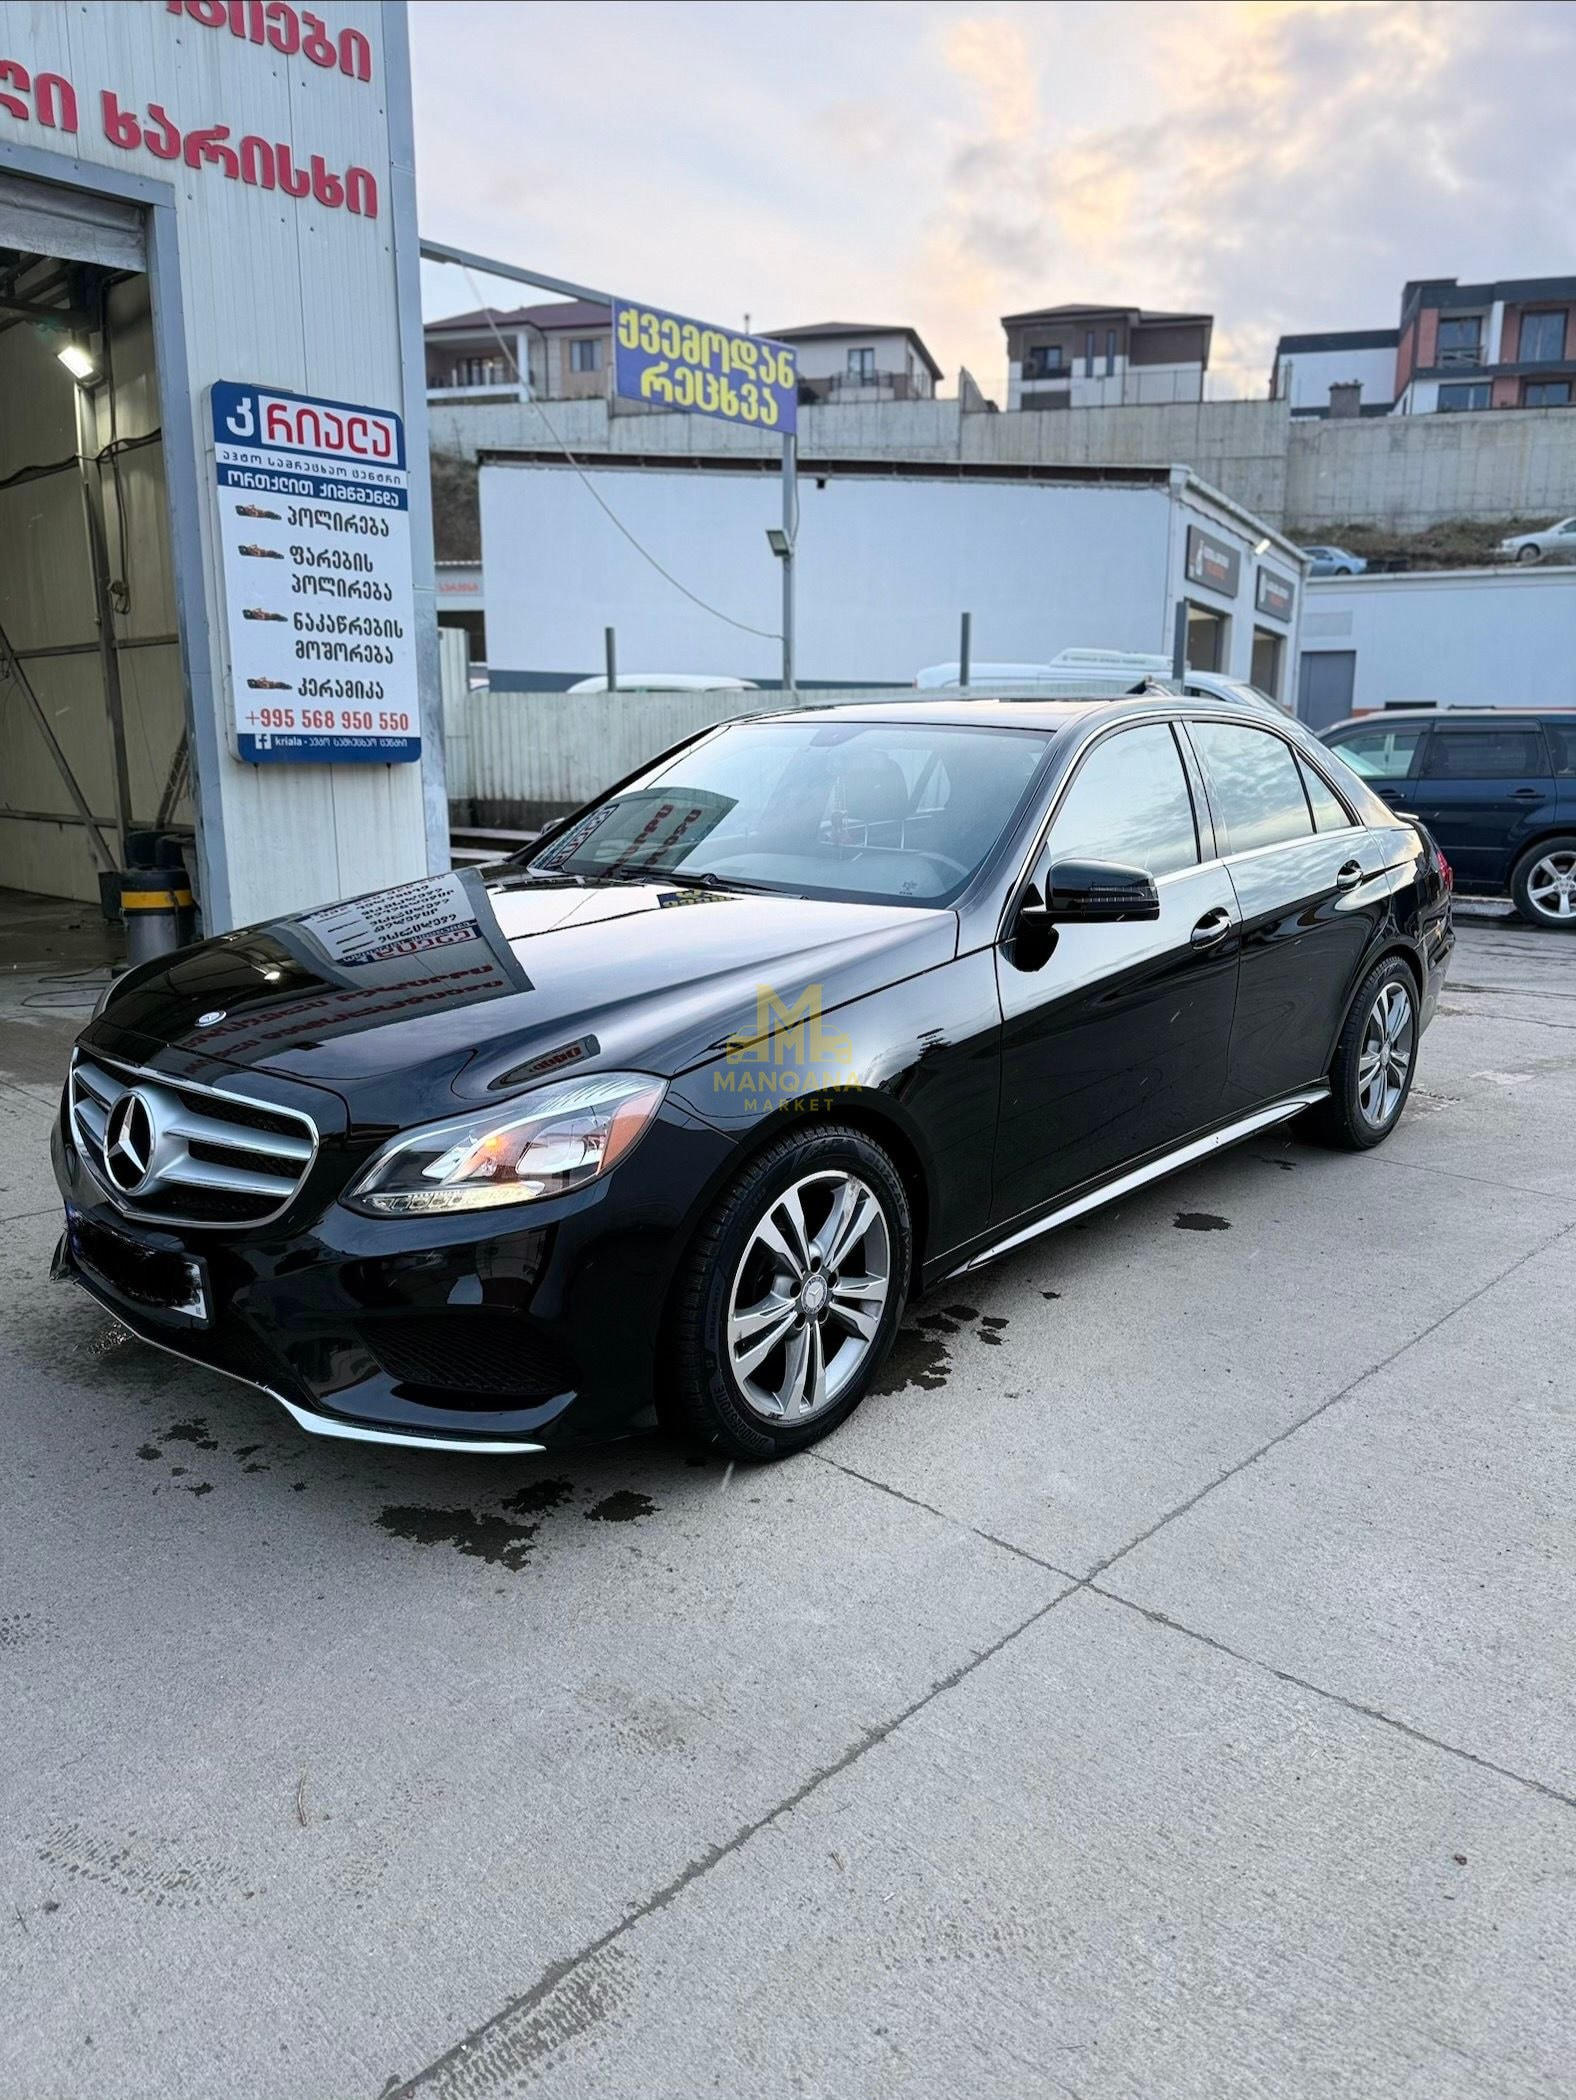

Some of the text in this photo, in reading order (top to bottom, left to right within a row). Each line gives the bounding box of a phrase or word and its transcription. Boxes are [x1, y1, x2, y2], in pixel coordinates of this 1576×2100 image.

[101, 89, 378, 219] ხარისხი
[618, 309, 794, 389] ქვემოდან
[641, 361, 778, 425] რეცხვა
[223, 450, 401, 485] ავტო სამრეცხაო ცენტრი
[228, 470, 314, 496] ორთქლით
[287, 505, 389, 537] პოლირება
[289, 545, 374, 573] ფარების
[292, 573, 393, 602] პოლირება
[293, 611, 403, 639] ნაკაწრების
[295, 639, 393, 664] მოშორება
[298, 677, 384, 700] კერამიკა
[245, 708, 409, 731] +995 568 950 550
[275, 736, 302, 747] kriala
